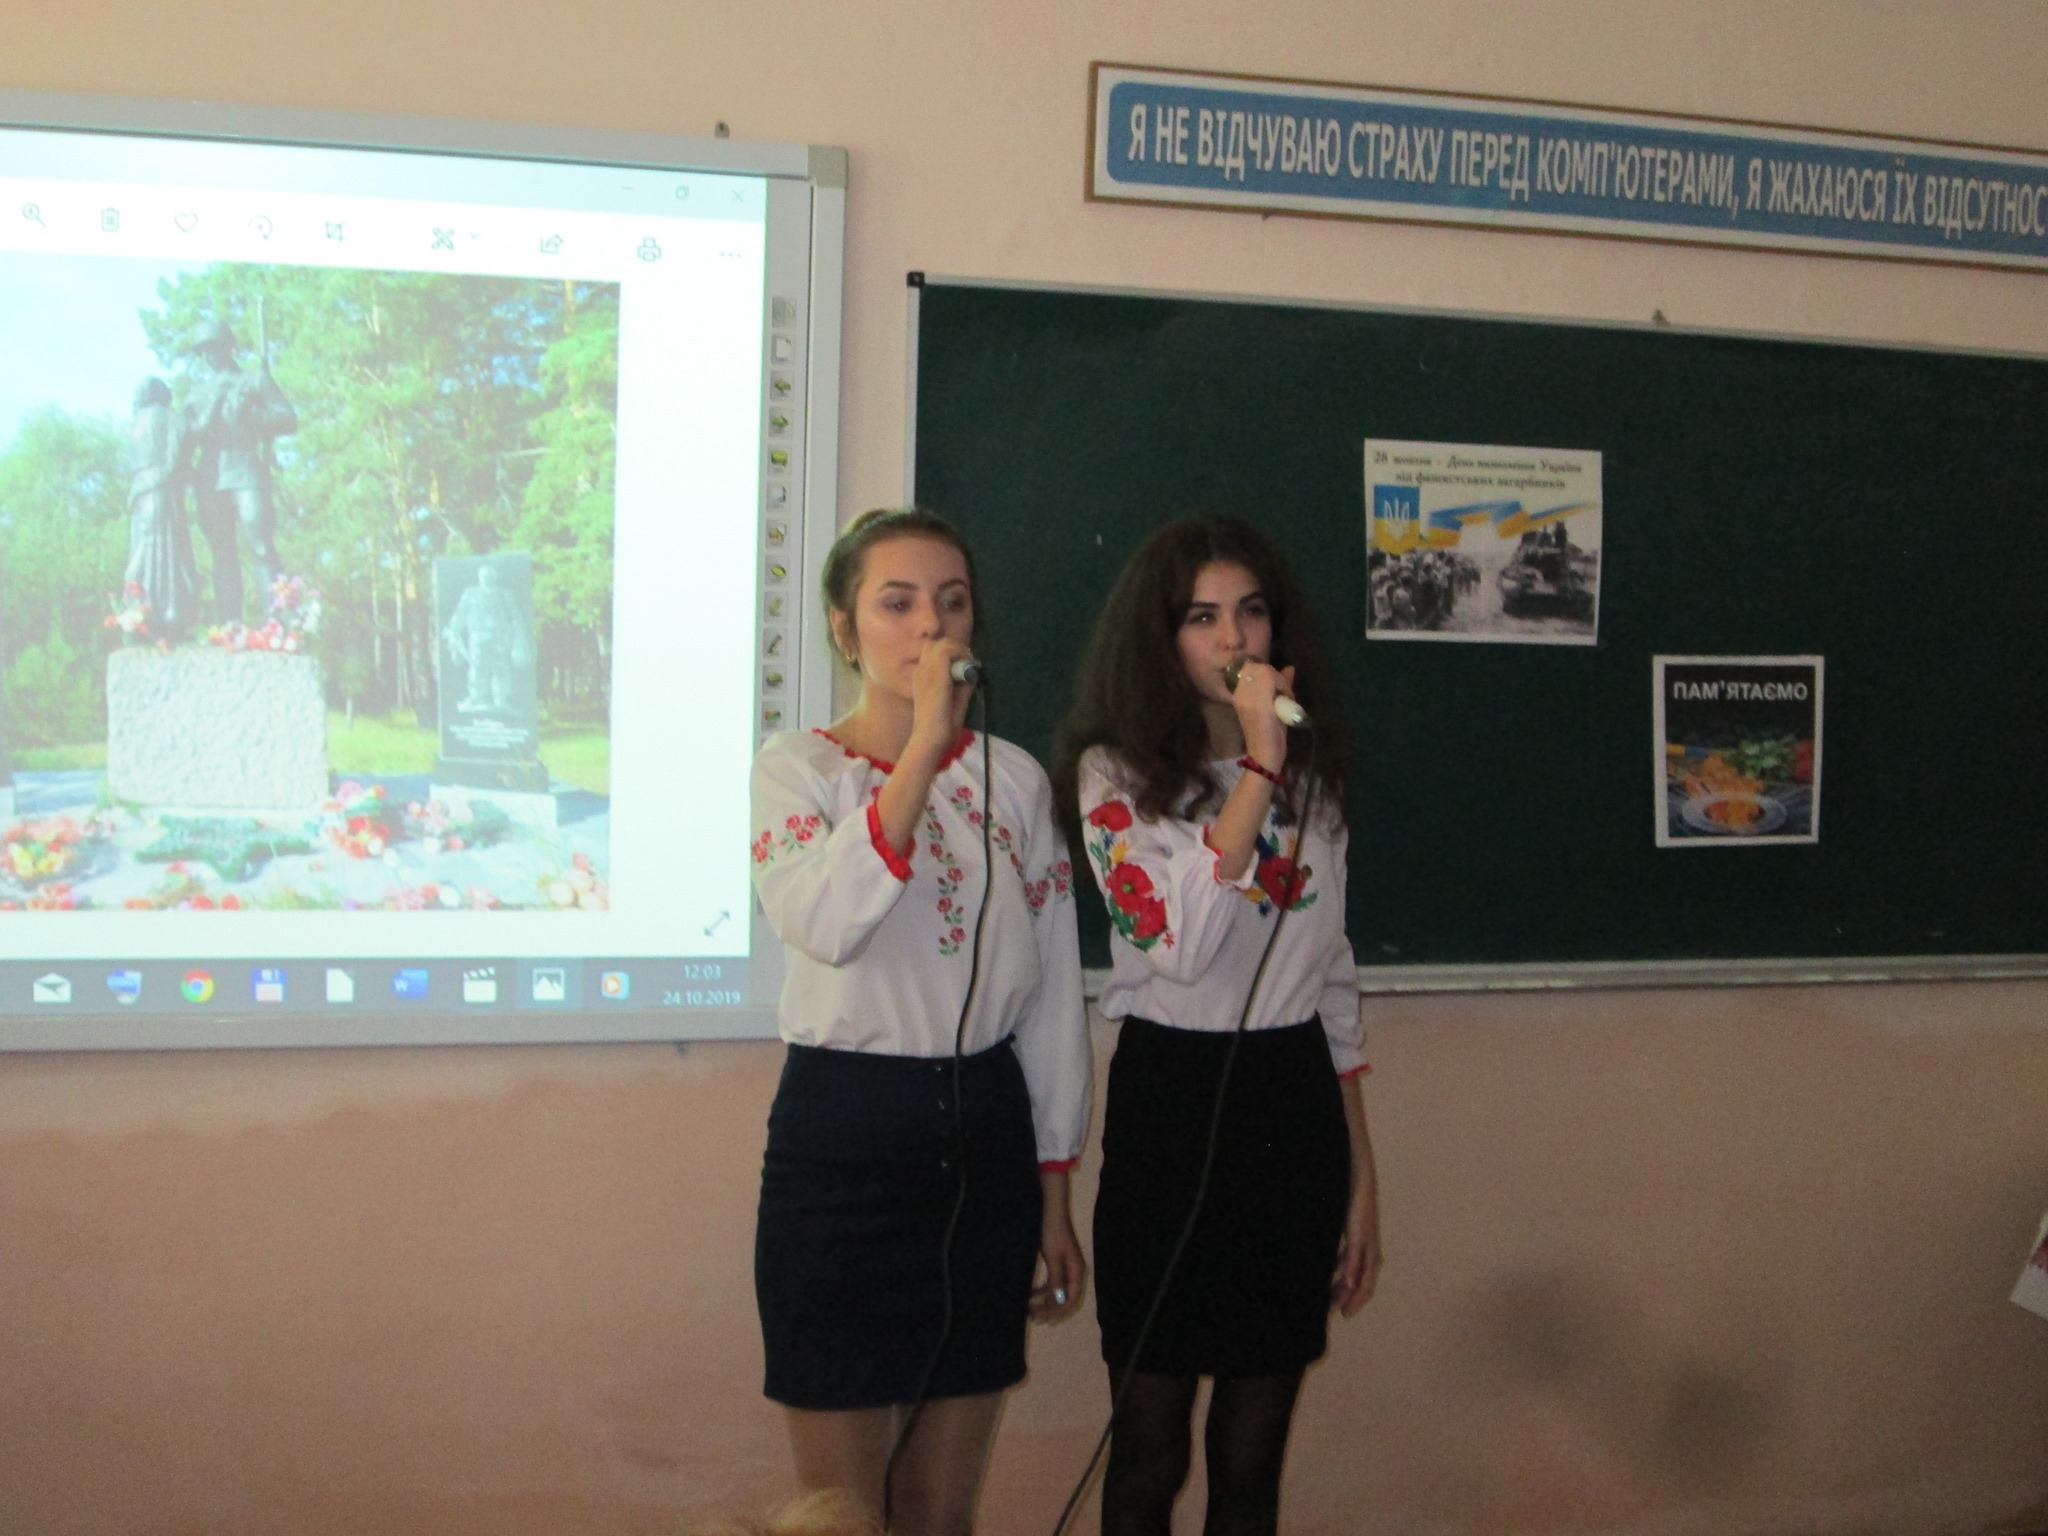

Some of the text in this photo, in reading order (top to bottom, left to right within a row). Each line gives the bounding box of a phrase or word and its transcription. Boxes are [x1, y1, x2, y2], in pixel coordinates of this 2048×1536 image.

[1128, 104, 2048, 240] Я НЕ ВІДЧУВАЮ СТРАХУ ПЕРЕД КОМП'ЮТЕРАМИ, Я ЖАХАЮСЯ ЇХ ВІДСУТНОС
[1672, 679, 1808, 701] ПАМ'ЯТАЄМО
